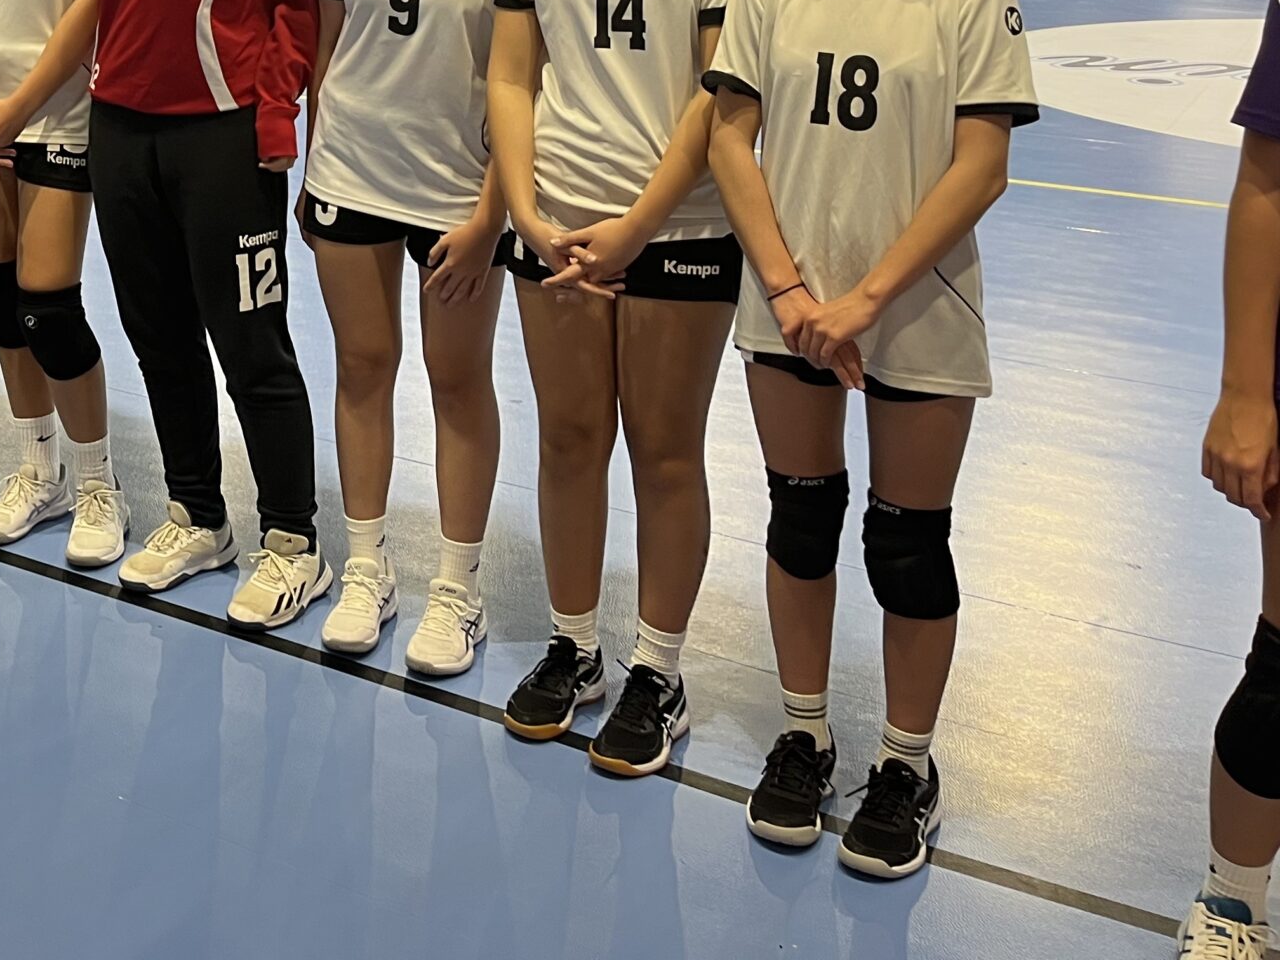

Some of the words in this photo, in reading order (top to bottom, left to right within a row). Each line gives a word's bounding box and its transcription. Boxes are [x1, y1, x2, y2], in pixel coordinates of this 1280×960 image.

[810, 51, 879, 132] 18
[46, 151, 87, 169] Kempa
[238, 229, 279, 249] Kempa
[663, 258, 721, 279] Kempa
[235, 247, 282, 313] 12
